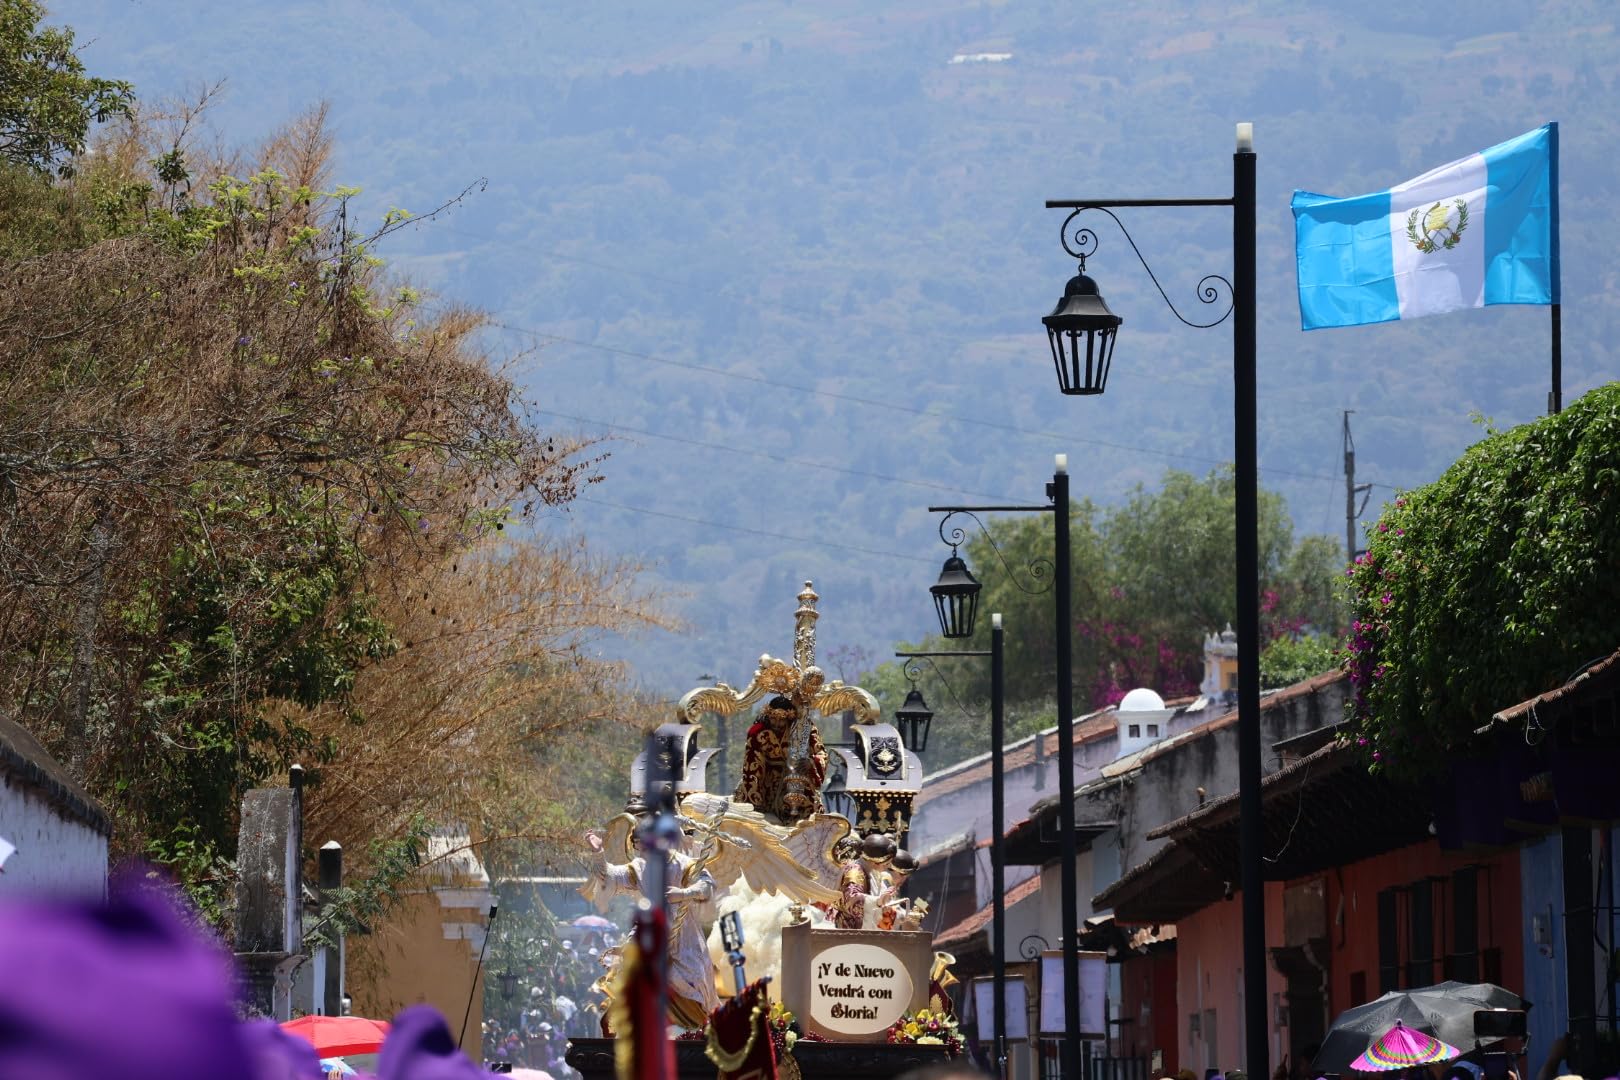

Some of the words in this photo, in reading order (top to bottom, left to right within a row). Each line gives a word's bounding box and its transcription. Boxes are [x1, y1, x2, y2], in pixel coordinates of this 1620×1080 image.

[818, 963, 831, 978] ¡Y
[835, 963, 851, 976] de
[854, 964, 895, 978] Nuevo
[818, 984, 865, 998] Vendrá
[868, 988, 893, 999] con
[830, 1002, 879, 1019] Gloria!
